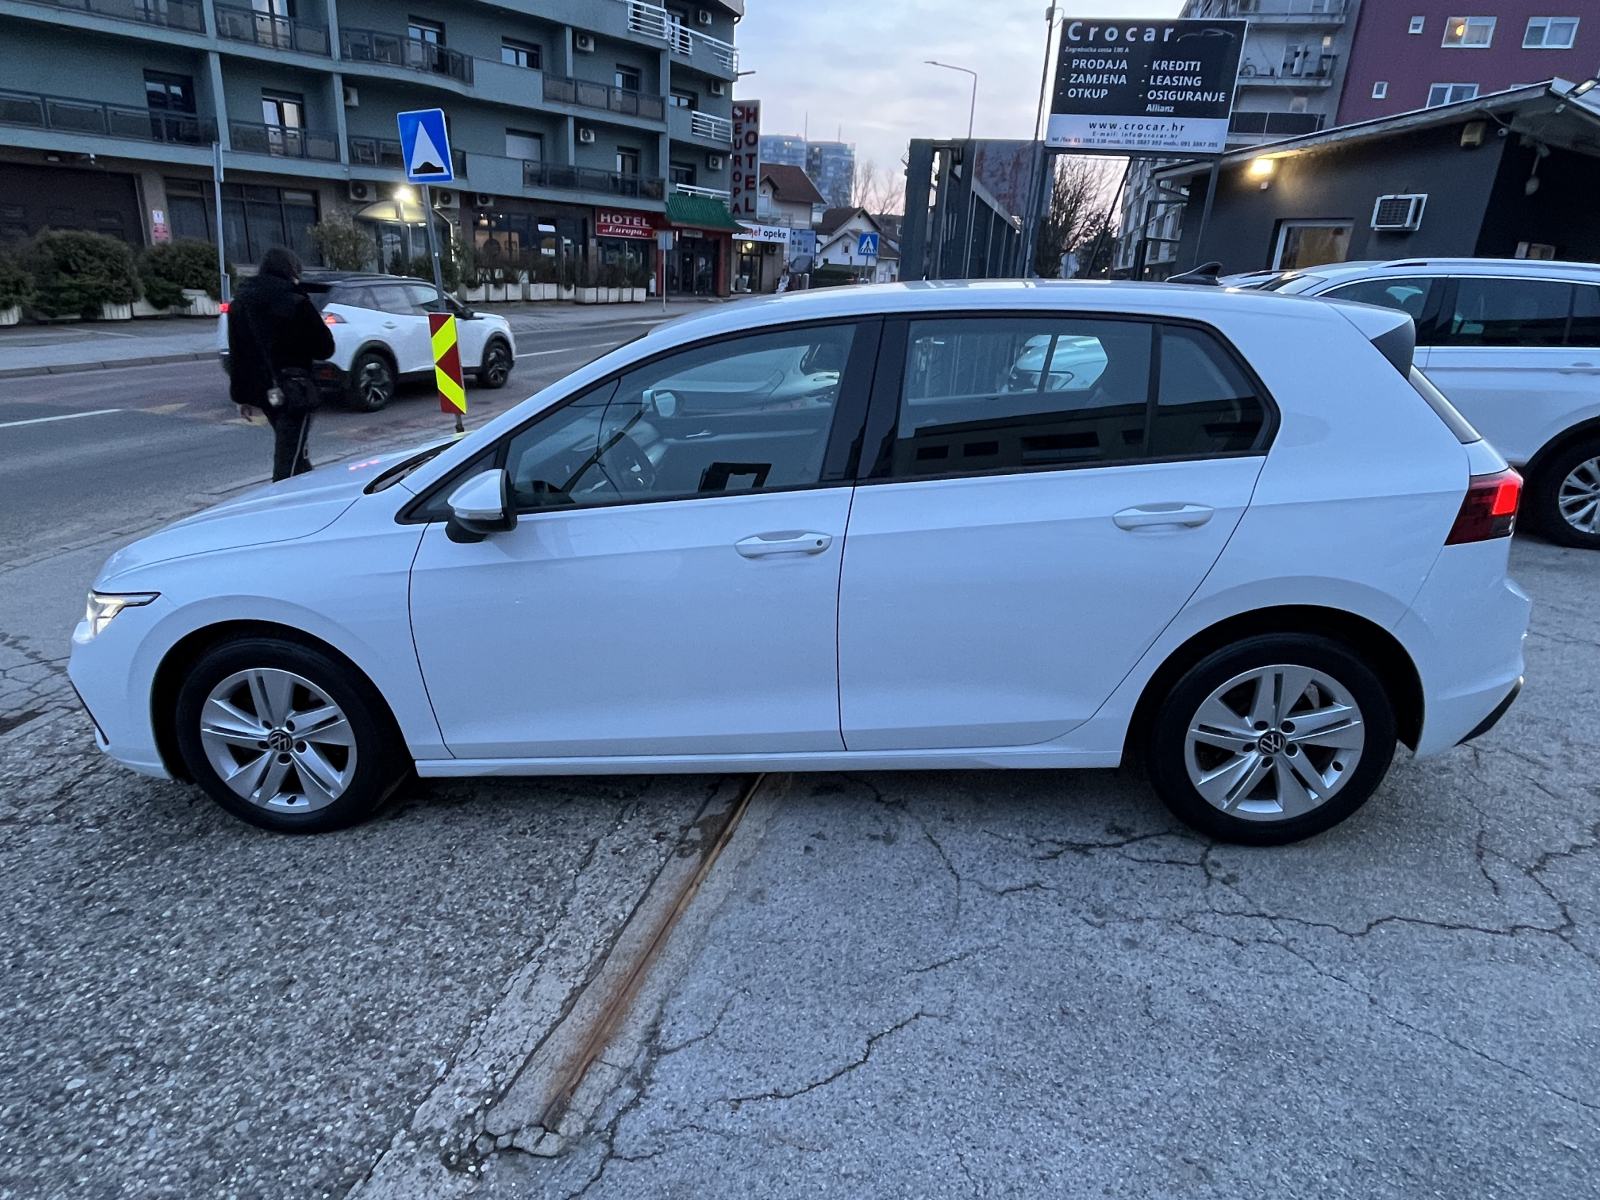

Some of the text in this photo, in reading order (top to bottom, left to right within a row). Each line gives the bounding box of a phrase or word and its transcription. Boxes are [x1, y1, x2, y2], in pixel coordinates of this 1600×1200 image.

[1068, 22, 1174, 42] Crocar
[1072, 59, 1128, 70] PRODAJA
[1152, 61, 1201, 71] KREDITI
[1069, 74, 1127, 84] ZAMJENA
[1150, 75, 1202, 86] LEASING
[1067, 88, 1108, 99] OTKUP
[1147, 90, 1226, 102] OSIGURANJE
[1146, 104, 1175, 113] Allianz
[1089, 122, 1185, 132] www.crocar.hr
[744, 106, 758, 213] HOTEL
[732, 122, 743, 215] EUROPA
[600, 213, 651, 227] HOTEL
[763, 229, 787, 240] opeke
